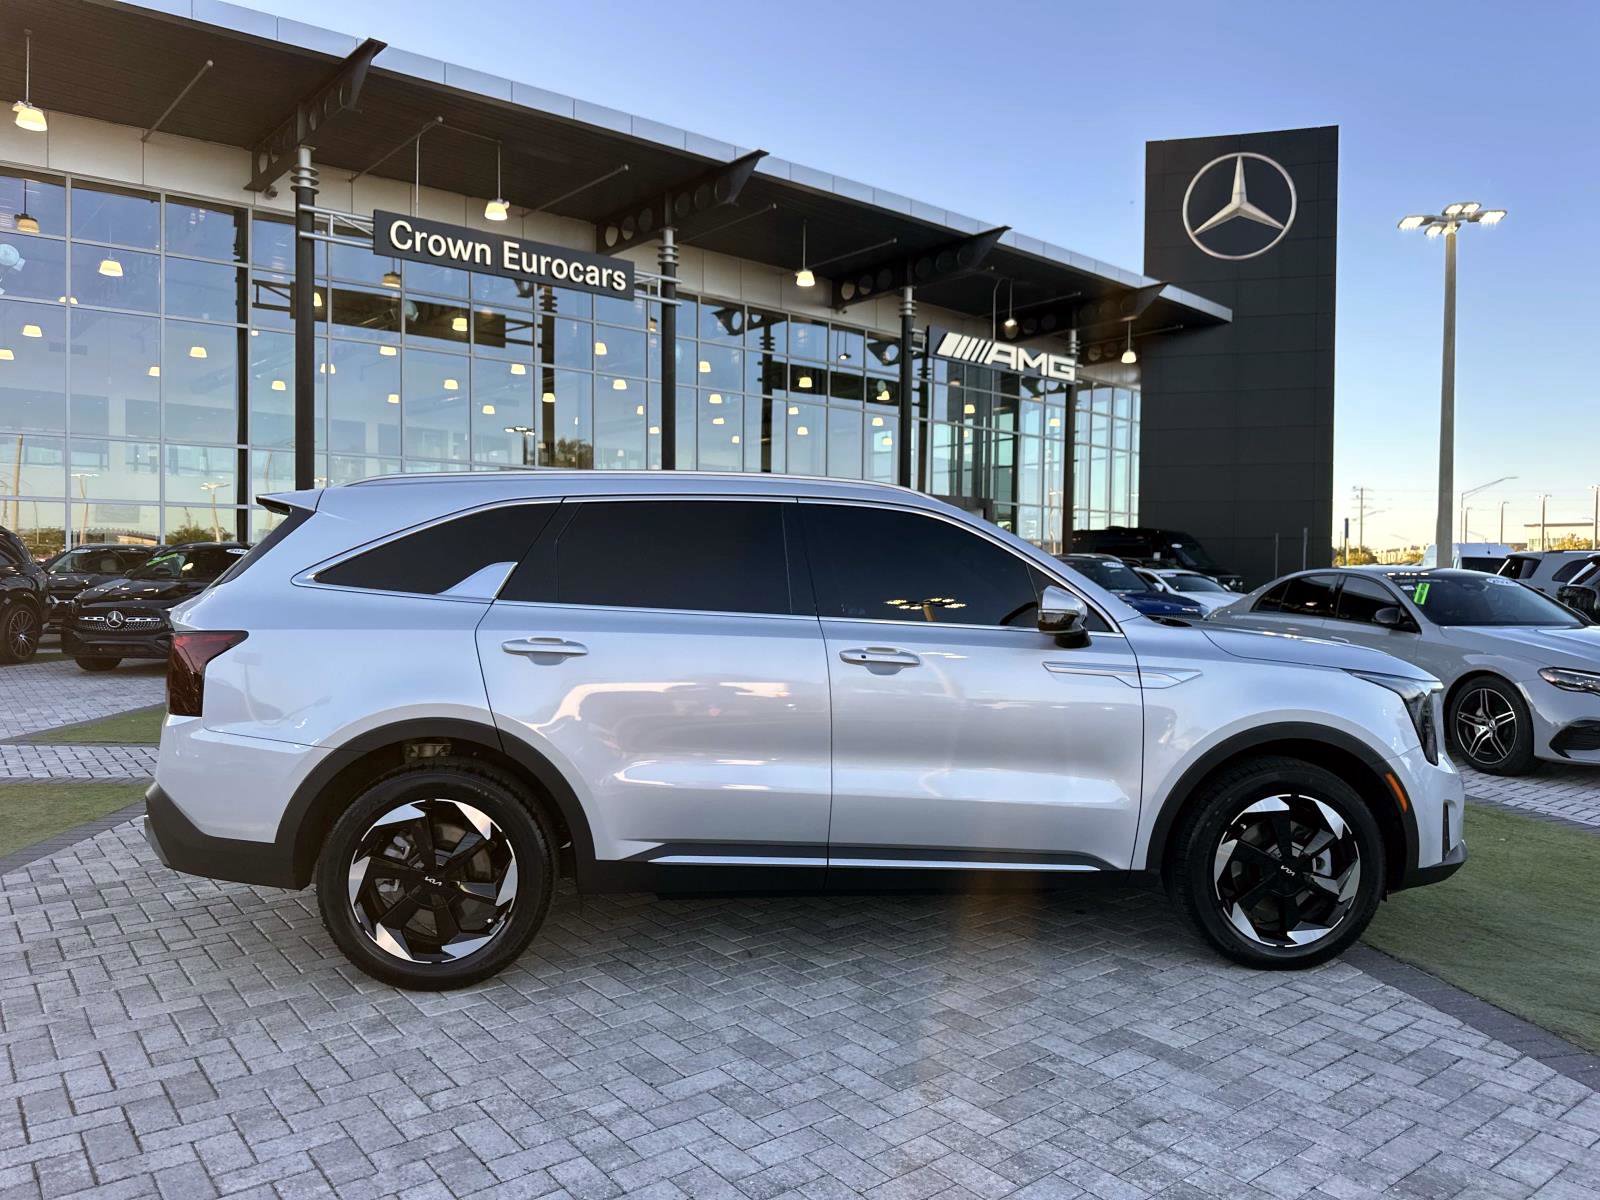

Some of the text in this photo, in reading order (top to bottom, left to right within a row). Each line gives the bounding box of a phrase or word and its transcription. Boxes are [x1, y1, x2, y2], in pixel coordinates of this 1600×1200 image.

[389, 219, 627, 291] Crown Eurocars
[984, 342, 1075, 381] AMG
